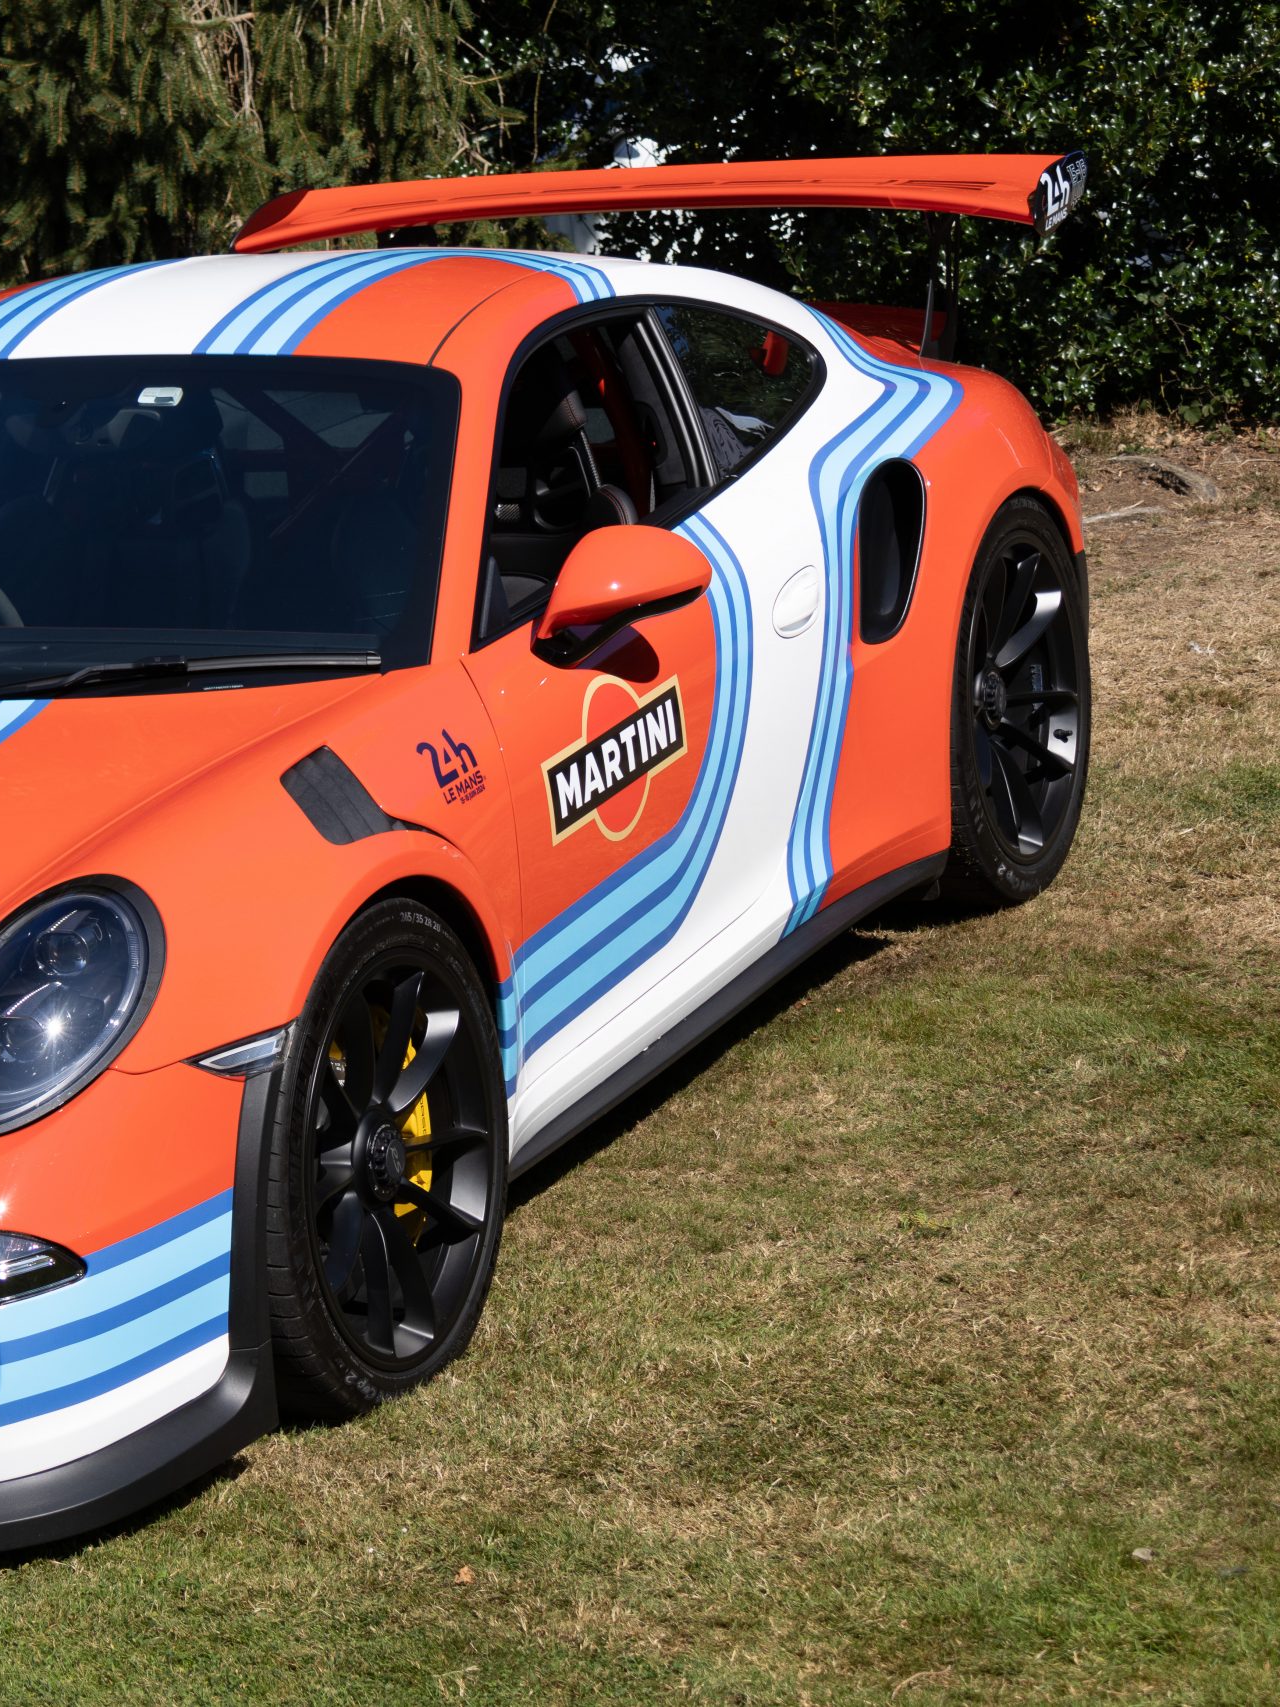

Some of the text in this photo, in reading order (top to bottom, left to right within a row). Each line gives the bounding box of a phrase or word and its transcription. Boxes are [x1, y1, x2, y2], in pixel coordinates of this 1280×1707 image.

[1040, 165, 1070, 216] 24h
[416, 728, 477, 788] 24h
[556, 699, 676, 819] MARTINI
[443, 770, 483, 804] LE MANS
